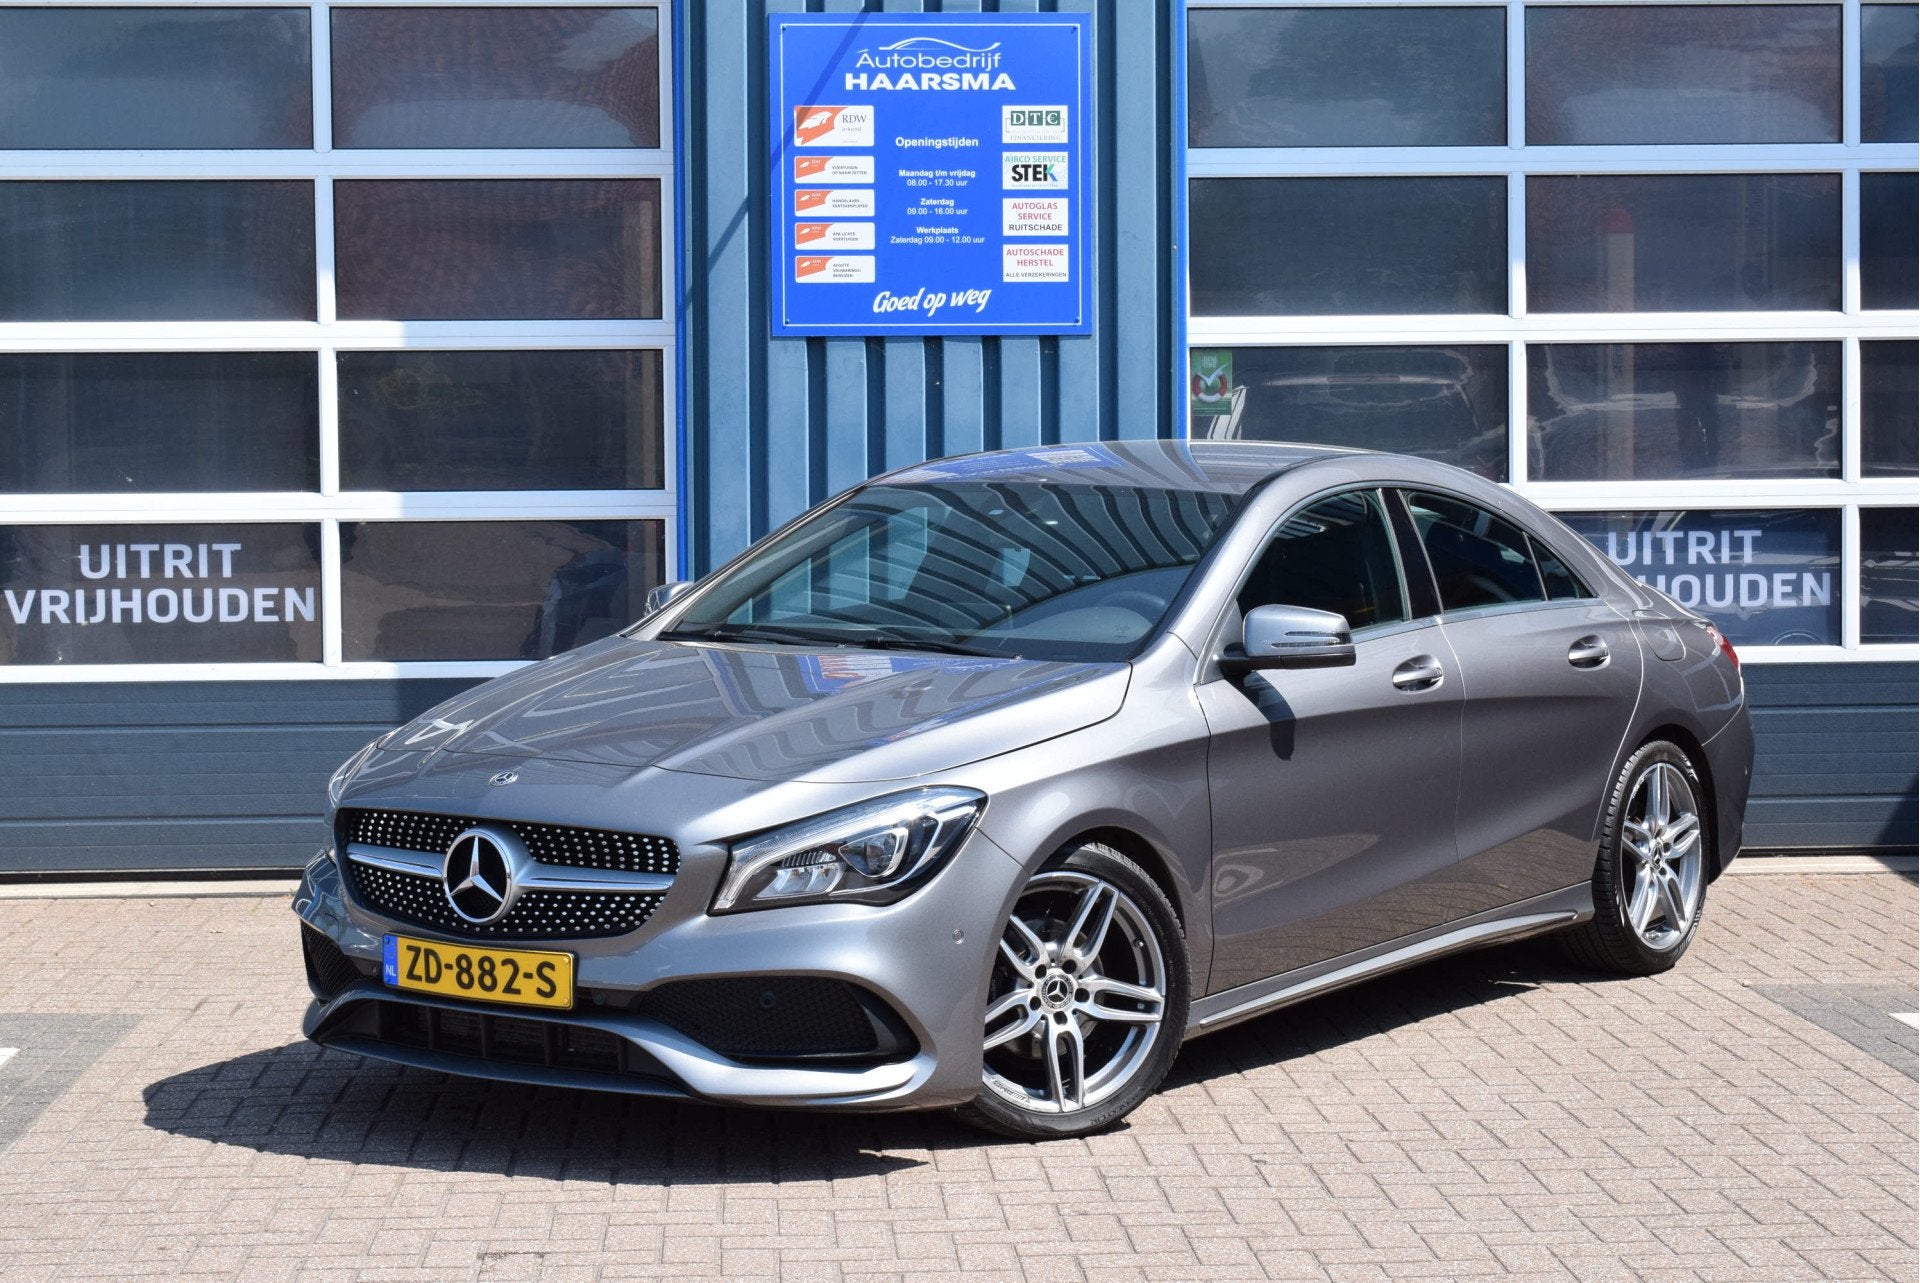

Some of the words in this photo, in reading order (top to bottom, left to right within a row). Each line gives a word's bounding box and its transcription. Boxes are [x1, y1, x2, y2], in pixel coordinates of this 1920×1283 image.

[855, 52, 1001, 72] Autobedrijf
[845, 72, 1016, 91] HAARSMA
[842, 114, 867, 123] RDW
[895, 137, 979, 149] Openingstijden
[1004, 155, 1031, 163] AIRCO
[1032, 155, 1067, 163] SERVICE
[898, 169, 934, 178] Maandag
[935, 169, 948, 177] t/m
[949, 169, 976, 178] vrijdag
[1011, 164, 1058, 182] STEK
[906, 179, 928, 187] 08.00
[934, 179, 954, 187] 17.30
[920, 198, 955, 207] Zaterdag
[1012, 202, 1058, 210] AUTOGLAS
[906, 207, 928, 215] 09.00
[934, 207, 954, 215] 16.00
[1017, 212, 1053, 221] SERVICE
[916, 226, 959, 235] Werkplaats
[1008, 223, 1063, 231] RUITSCHADE
[890, 236, 923, 245] Zaterdag
[924, 236, 945, 244] 09.00
[952, 236, 972, 244] 12.00
[1006, 248, 1064, 256] AUTOSCHADE
[1016, 259, 1054, 267] HERSTEL
[872, 287, 926, 313] Goed
[923, 292, 947, 317] op
[949, 288, 992, 313] weg
[1607, 530, 1762, 566] UITRIT
[80, 543, 242, 579] UITRIT
[3, 587, 315, 625] VRIJHOUDEN
[385, 964, 397, 977] NL
[405, 944, 557, 999] ZD-882-S
